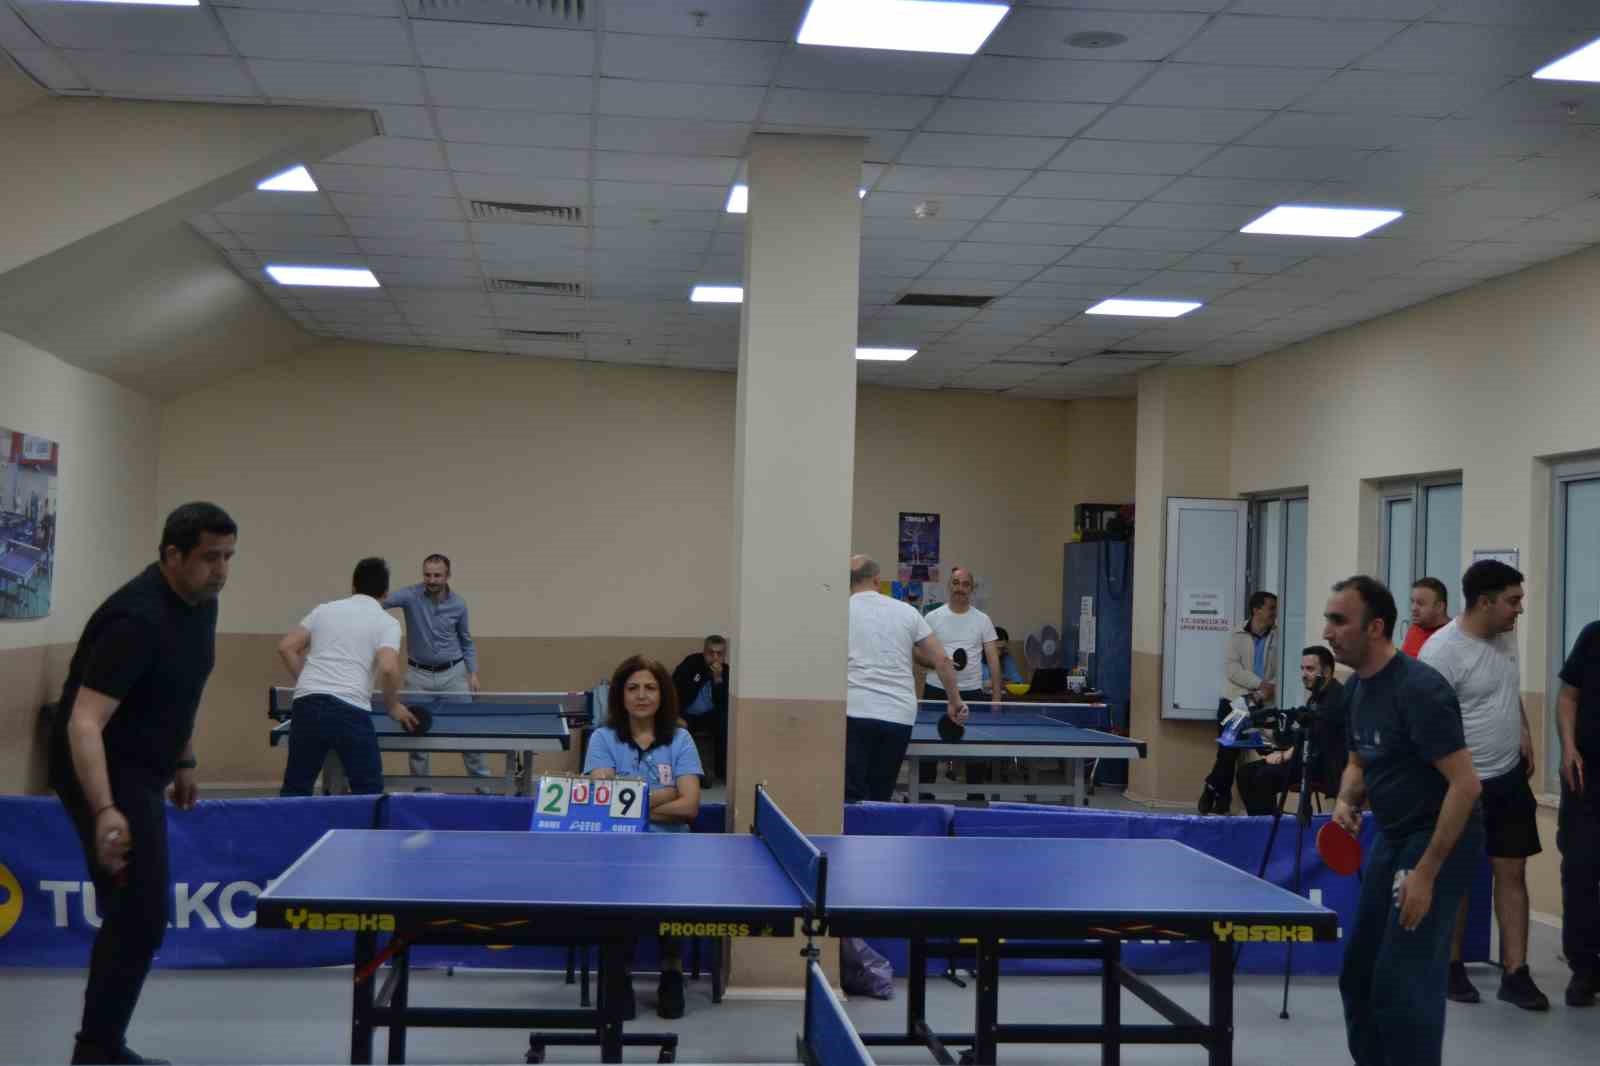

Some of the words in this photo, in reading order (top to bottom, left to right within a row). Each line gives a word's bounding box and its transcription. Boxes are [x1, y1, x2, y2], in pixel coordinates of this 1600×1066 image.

[544, 783, 564, 812] 2
[573, 784, 588, 803] 0
[595, 785, 610, 804] 0
[618, 788, 636, 816] 9
[40, 880, 276, 930] TUKC
[286, 908, 396, 932] Yasaka
[659, 922, 750, 937] PROGRESS
[1213, 921, 1313, 944] Yasaka
